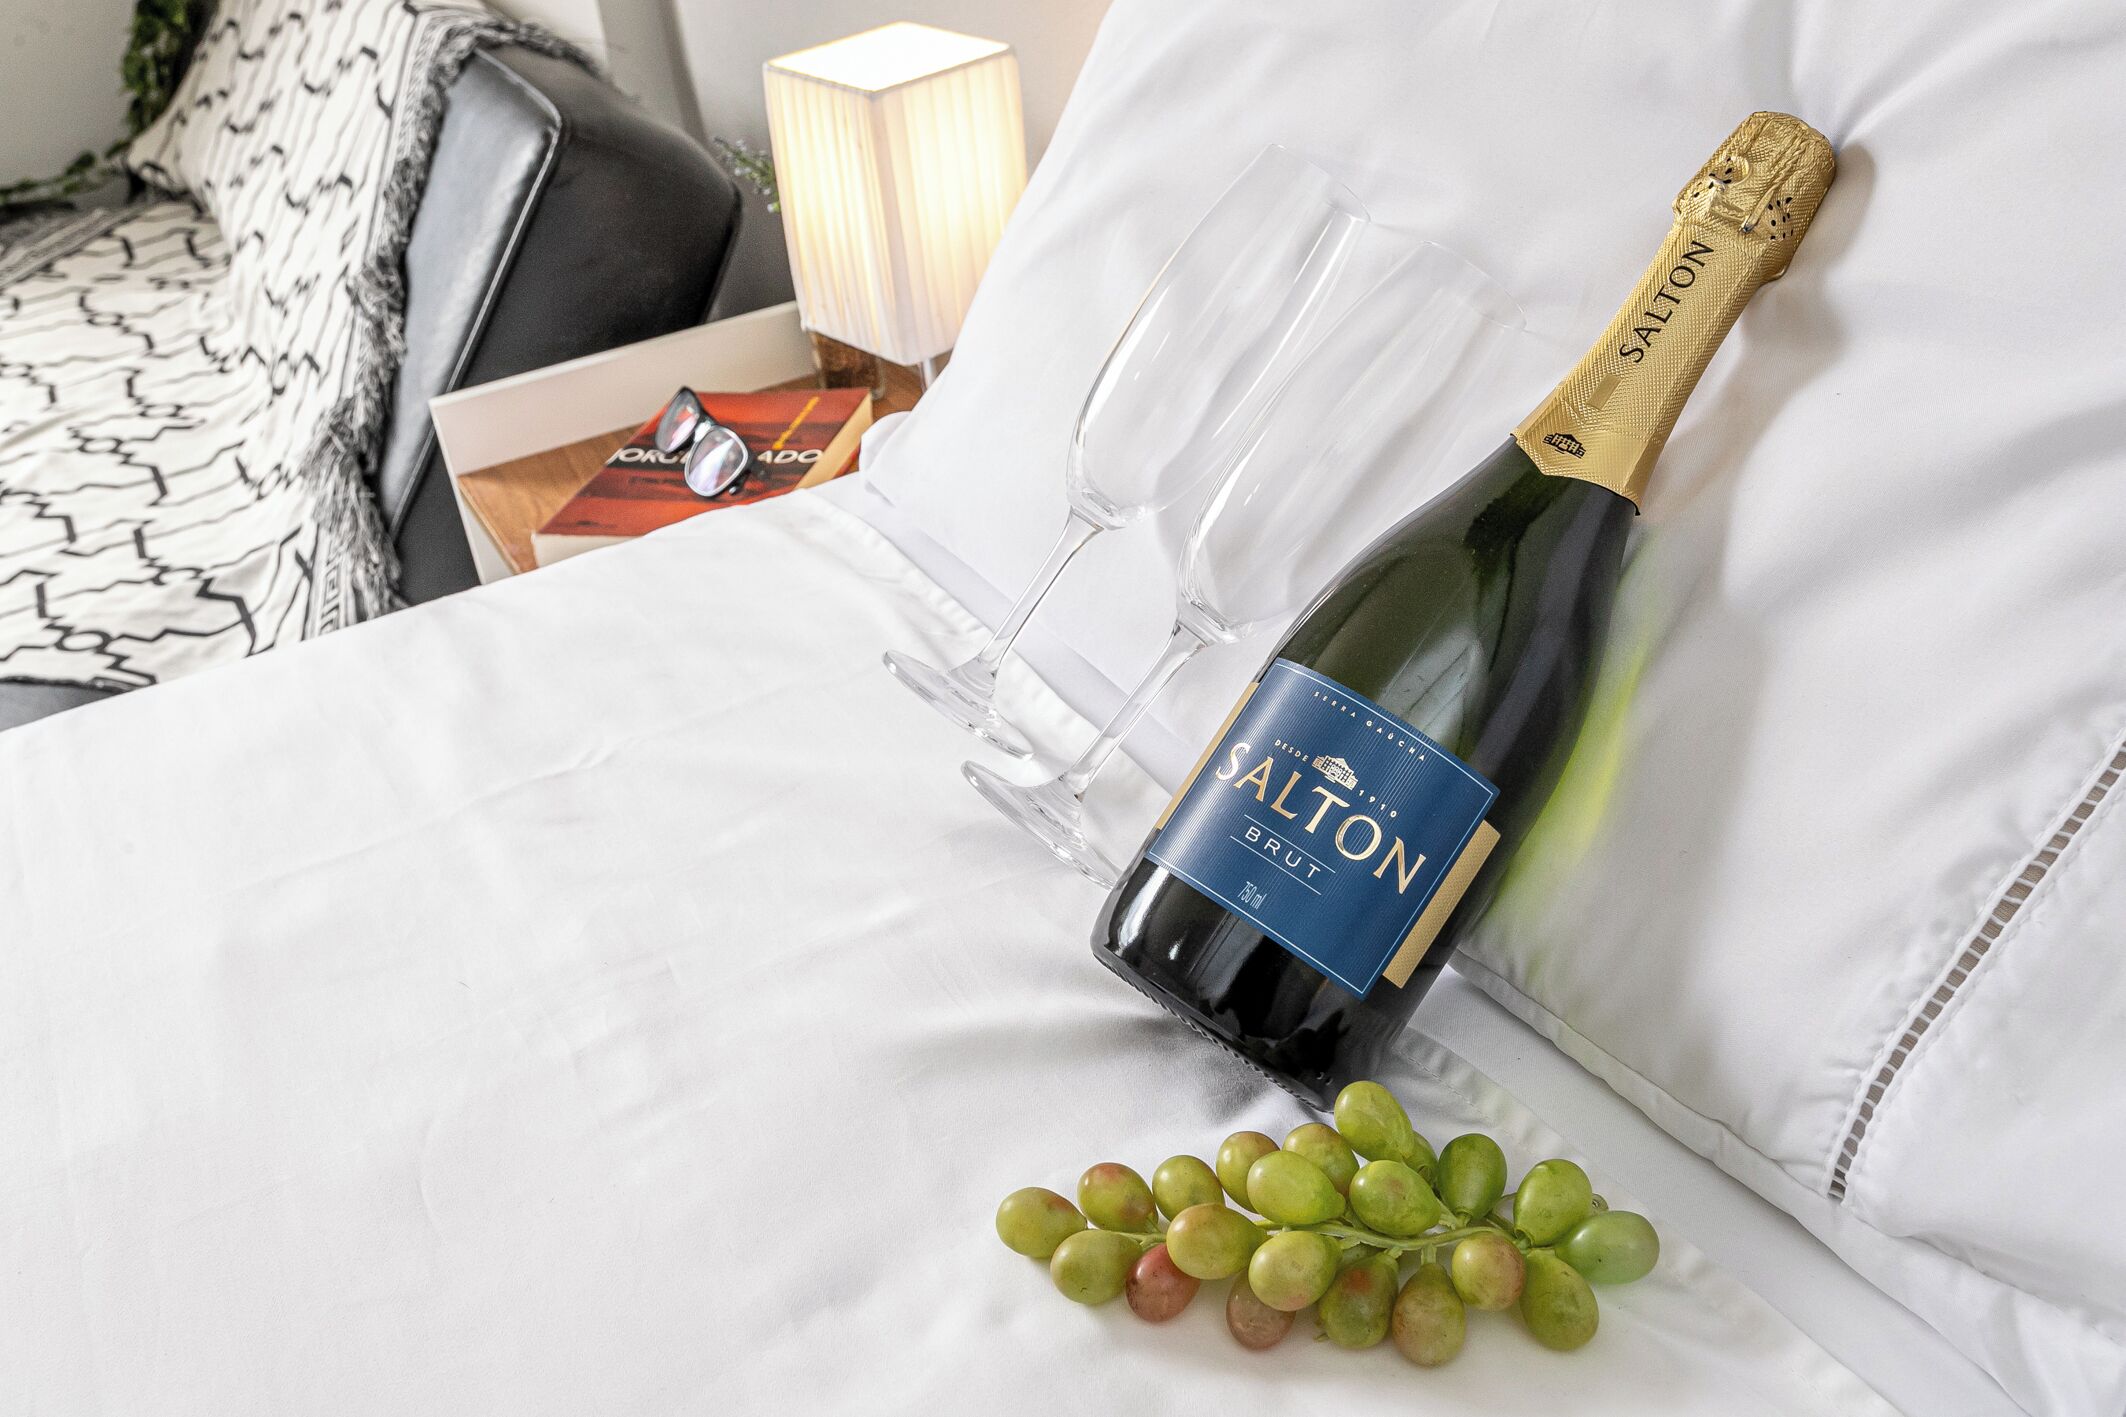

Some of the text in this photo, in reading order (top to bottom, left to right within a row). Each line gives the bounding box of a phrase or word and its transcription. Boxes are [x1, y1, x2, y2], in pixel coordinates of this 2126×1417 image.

[1619, 240, 1715, 363] SALTON
[604, 447, 824, 465] JORG ADO
[1313, 691, 1425, 761] SERRA GAÚCHA
[1274, 739, 1397, 818] DESDE 1910
[1215, 742, 1427, 895] SALTON
[1245, 826, 1321, 879] BRUT
[1237, 881, 1267, 910] 750 ml
